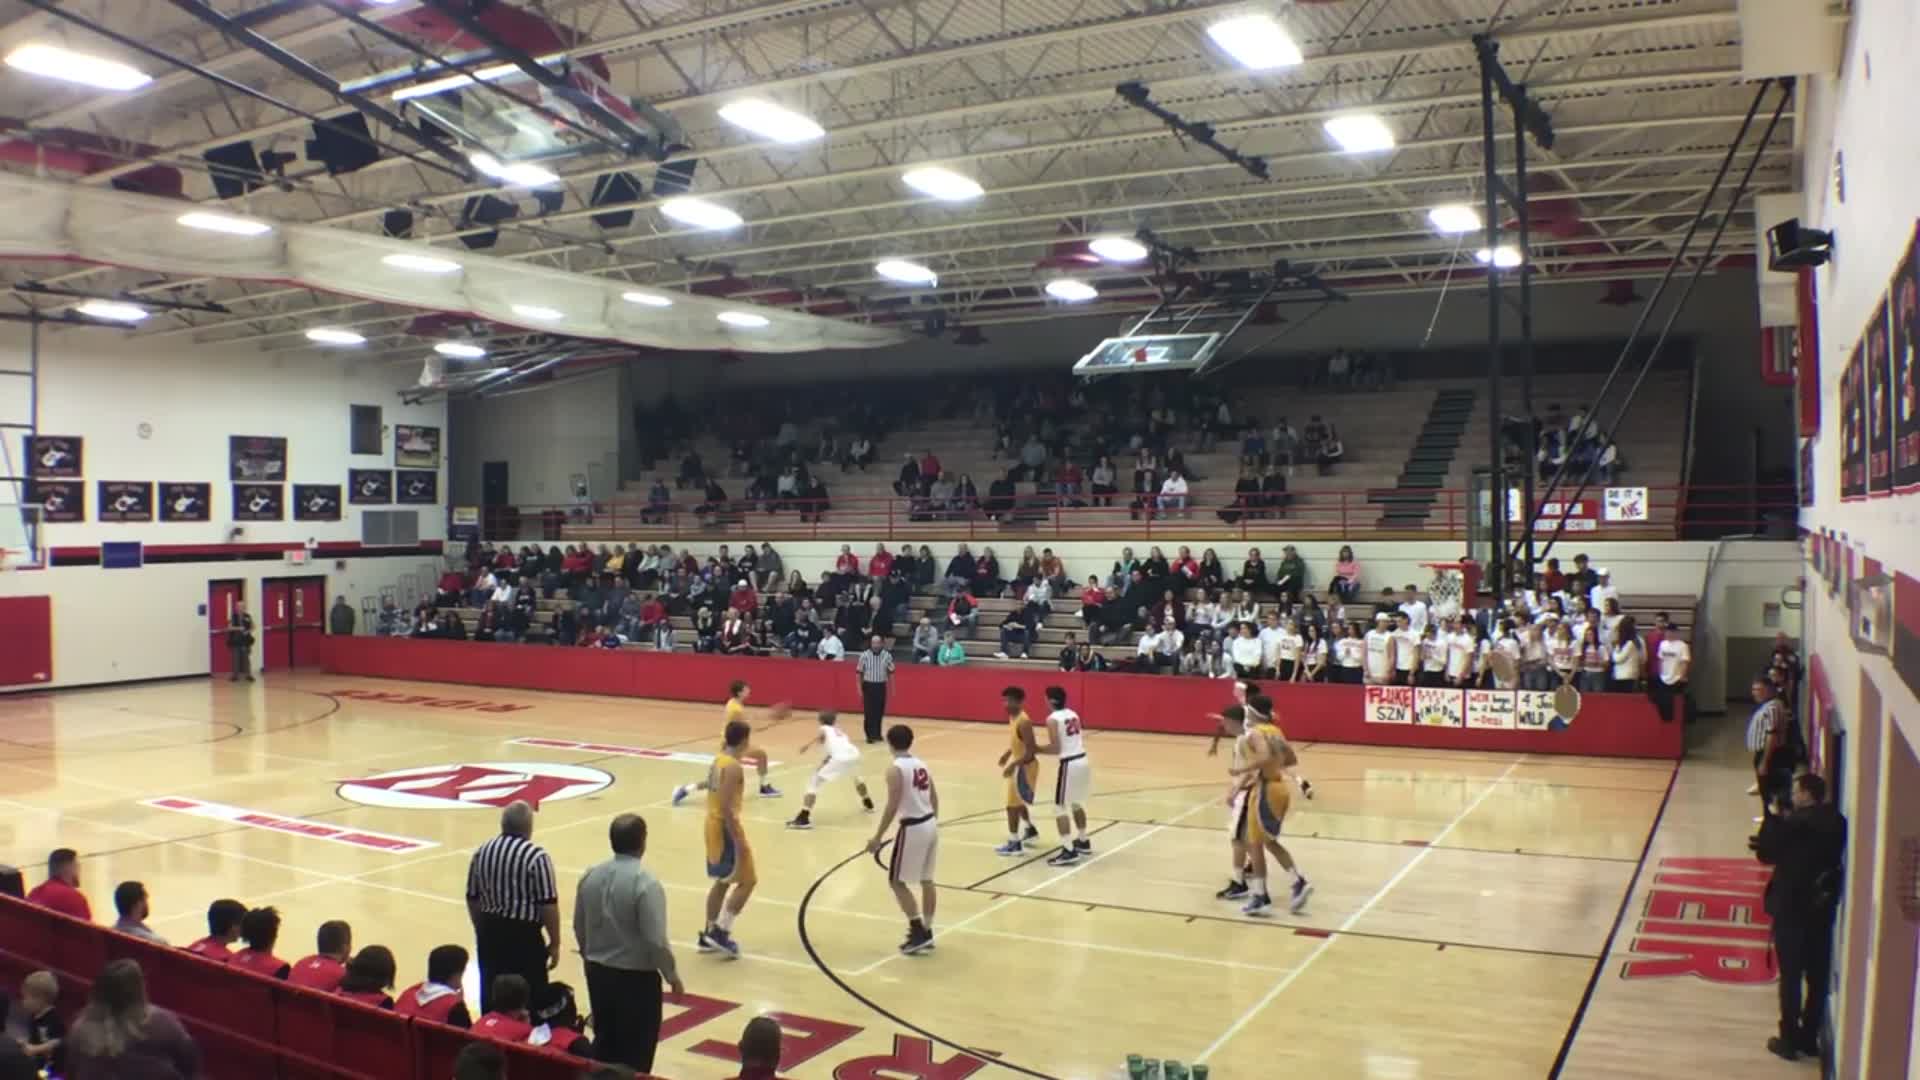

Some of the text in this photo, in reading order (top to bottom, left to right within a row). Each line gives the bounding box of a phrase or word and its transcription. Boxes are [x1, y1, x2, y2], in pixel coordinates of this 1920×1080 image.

[1368, 687, 1411, 707] FLUKE
[1376, 706, 1406, 720] SZN
[912, 767, 929, 791] 42
